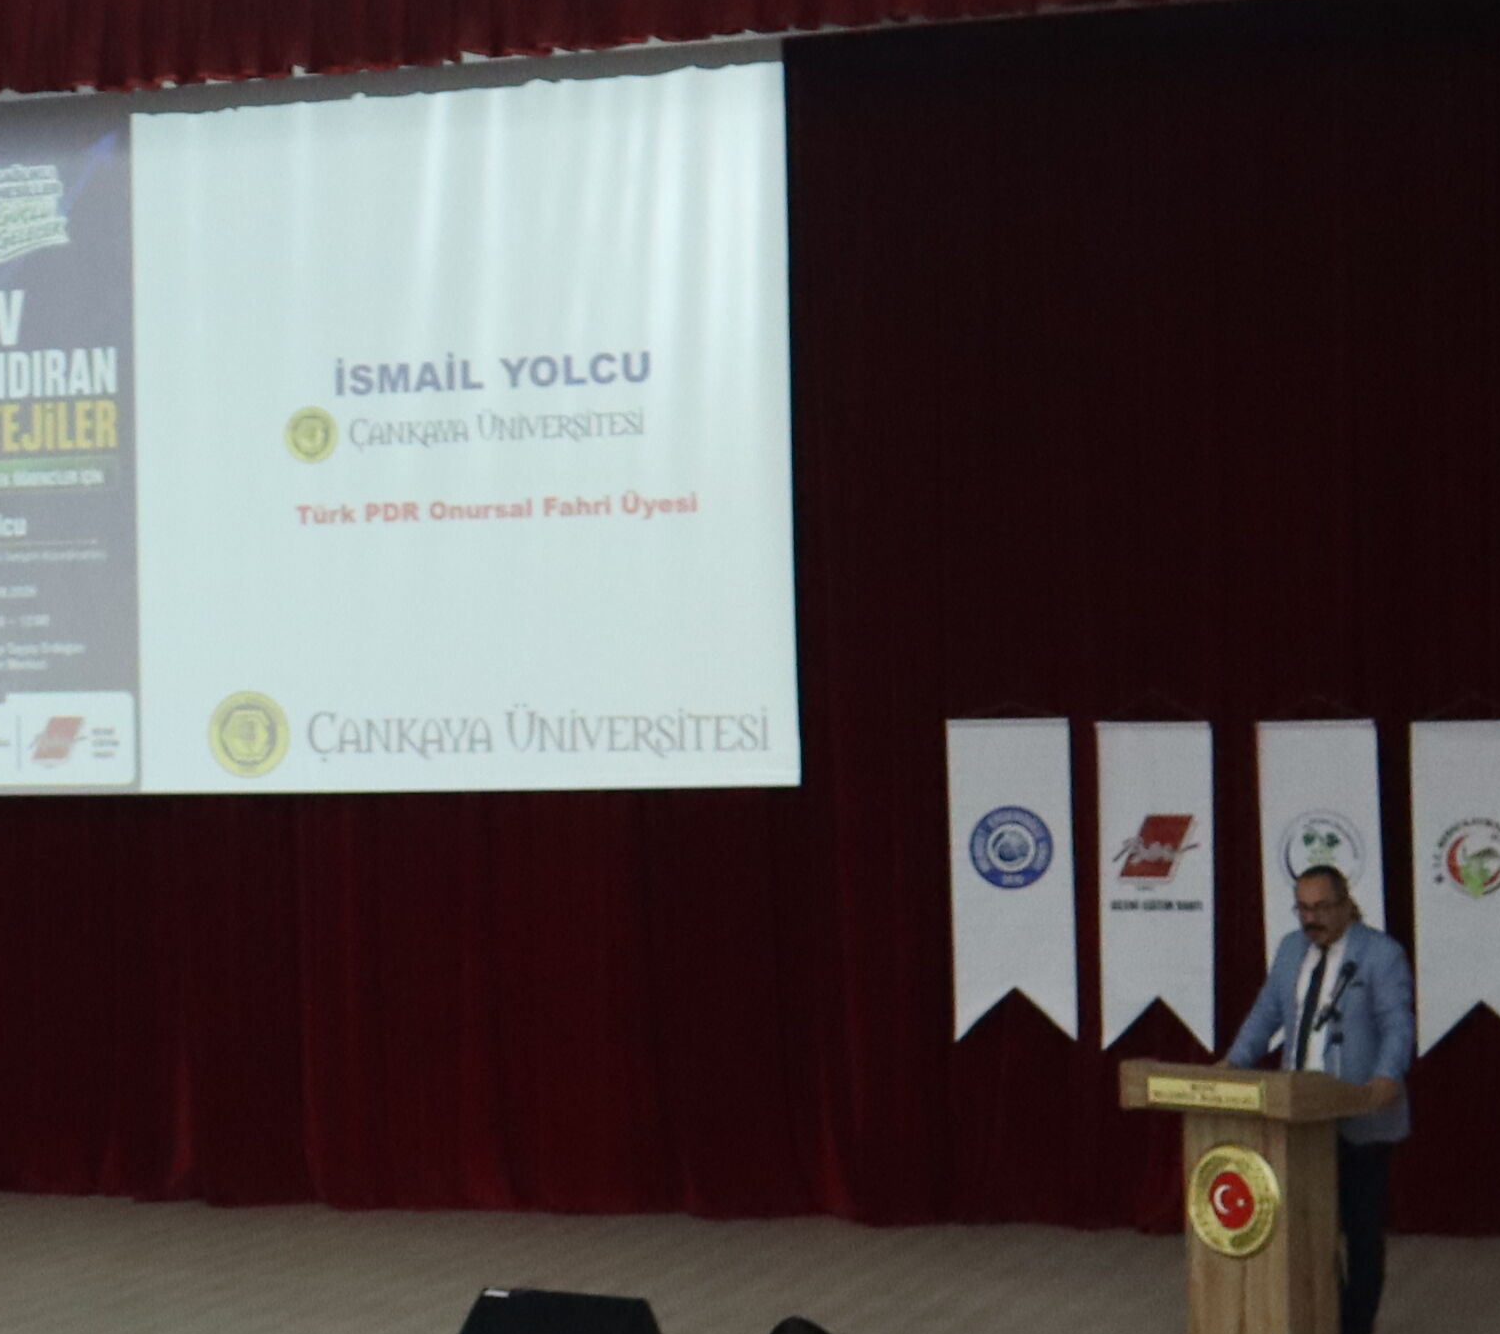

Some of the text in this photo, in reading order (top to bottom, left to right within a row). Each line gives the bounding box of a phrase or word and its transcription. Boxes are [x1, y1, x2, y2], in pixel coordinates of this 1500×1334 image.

[334, 351, 651, 397] İSMAİL YOLCU
[348, 407, 645, 452] ÇANKAYA ÜNİVERSİTESİ
[297, 490, 698, 526] Türk PDR Onursal Fahri Üyesi
[306, 703, 770, 763] ÇANKAYA ÜNİVERSİTESİ
